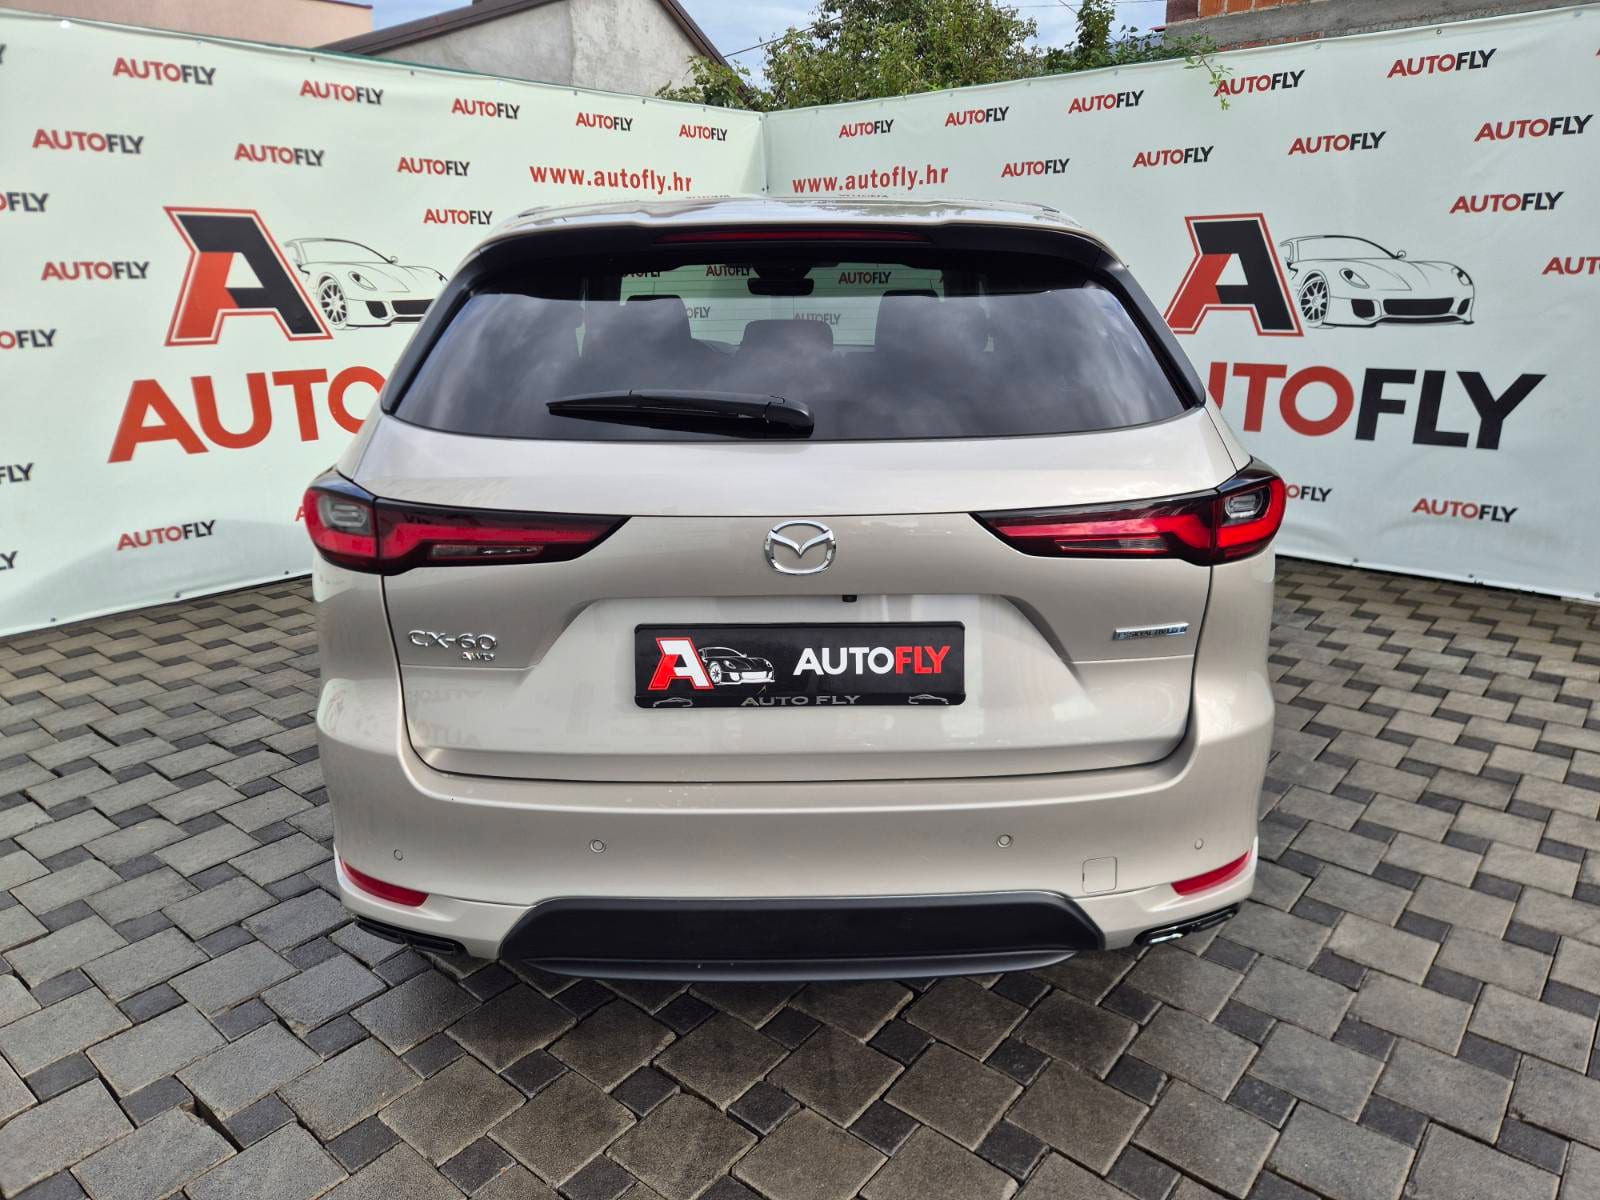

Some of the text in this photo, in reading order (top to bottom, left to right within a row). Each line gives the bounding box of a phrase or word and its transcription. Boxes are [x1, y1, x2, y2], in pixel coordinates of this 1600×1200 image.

[113, 58, 216, 85] AUTOFLY
[1387, 48, 1497, 78] AUTOFLY
[300, 80, 383, 105] AUTOFLY
[1214, 69, 1305, 97] AUTOFLY
[452, 98, 520, 119] AUTOFLY
[1068, 90, 1144, 114] AUTOFLY
[576, 112, 633, 131] AUTOFLY
[945, 106, 1010, 126] AUTOFLY
[679, 124, 728, 141] AUTOFLY
[839, 119, 894, 139] AUTOFLY
[1474, 114, 1594, 142] AUTOFLY
[32, 129, 144, 154] AUTOFLY
[1288, 131, 1386, 155] AUTOFLY
[235, 143, 324, 166] AUTOFLY
[1133, 146, 1214, 168] AUTOFLY
[397, 157, 470, 176] AUTOFLY
[1001, 158, 1070, 178] AUTOFLY
[529, 165, 692, 195] www.autofly.hr
[792, 164, 949, 193] www.autofly.hr
[1450, 191, 1564, 213] AUTOFLY
[424, 208, 493, 225] AUTOFLY
[42, 262, 149, 280] AUTOFLY
[838, 271, 892, 285] AUTOFLY
[1412, 498, 1518, 523] AUTOFLY
[117, 520, 216, 550] AUTOFLY
[407, 629, 497, 651] CX-60
[792, 645, 950, 676] AUTOFLY
[740, 695, 861, 707] AUTO FLY
